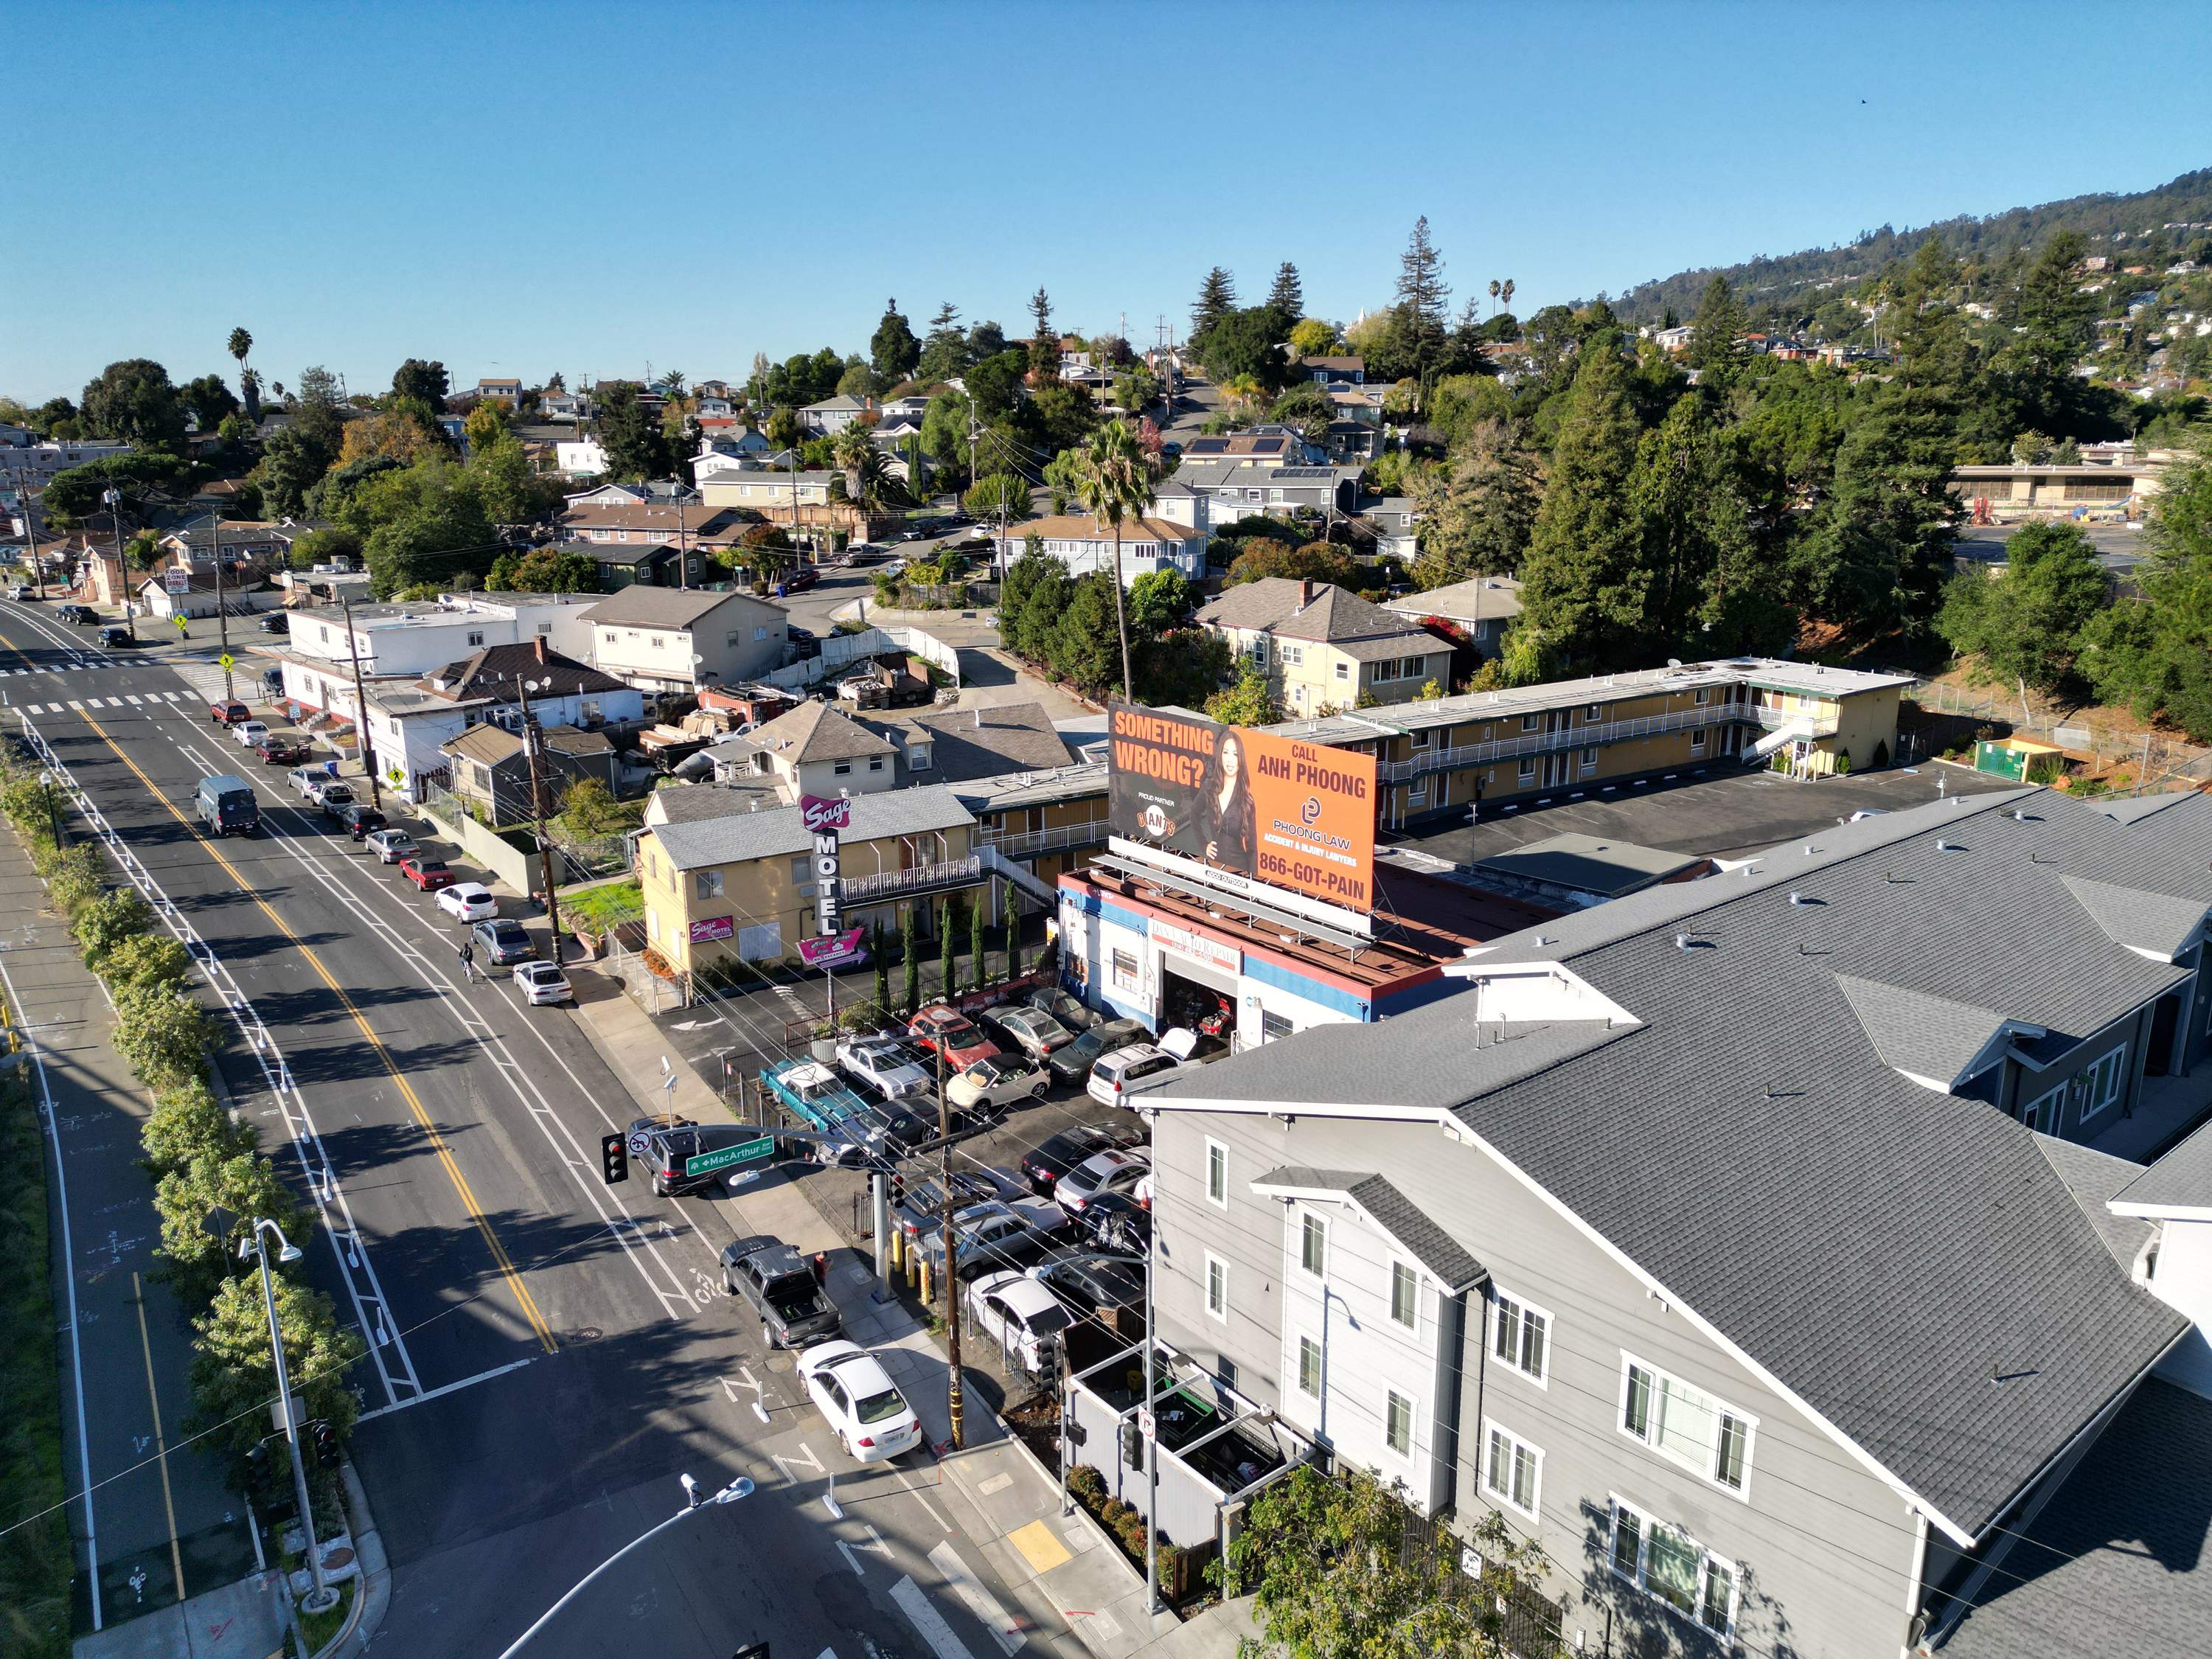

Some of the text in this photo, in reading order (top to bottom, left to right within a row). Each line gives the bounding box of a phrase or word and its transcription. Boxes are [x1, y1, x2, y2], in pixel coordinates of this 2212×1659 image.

[1115, 711, 1214, 755] SOMETHING
[1115, 740, 1204, 788] WRONG?
[1292, 745, 1318, 762] CALL
[1258, 754, 1366, 799] ANH PHOONG
[805, 799, 850, 830] Sage
[1138, 792, 1175, 807] PROUD PARTNER
[1137, 812, 1175, 836] GIANTS
[1273, 820, 1350, 850] PHOONG LAW
[1264, 833, 1294, 848] ACCIDENT
[1301, 843, 1324, 857] INJURY
[1326, 850, 1357, 867] LAWYERS
[816, 836, 837, 936] MOTEL
[1207, 871, 1247, 888] ADCO OUTDOOR
[1259, 852, 1364, 901] 866-GOT-PAIN
[692, 922, 716, 936] Sage
[824, 951, 845, 959] VACANCY
[710, 1145, 760, 1166] MacArthur
